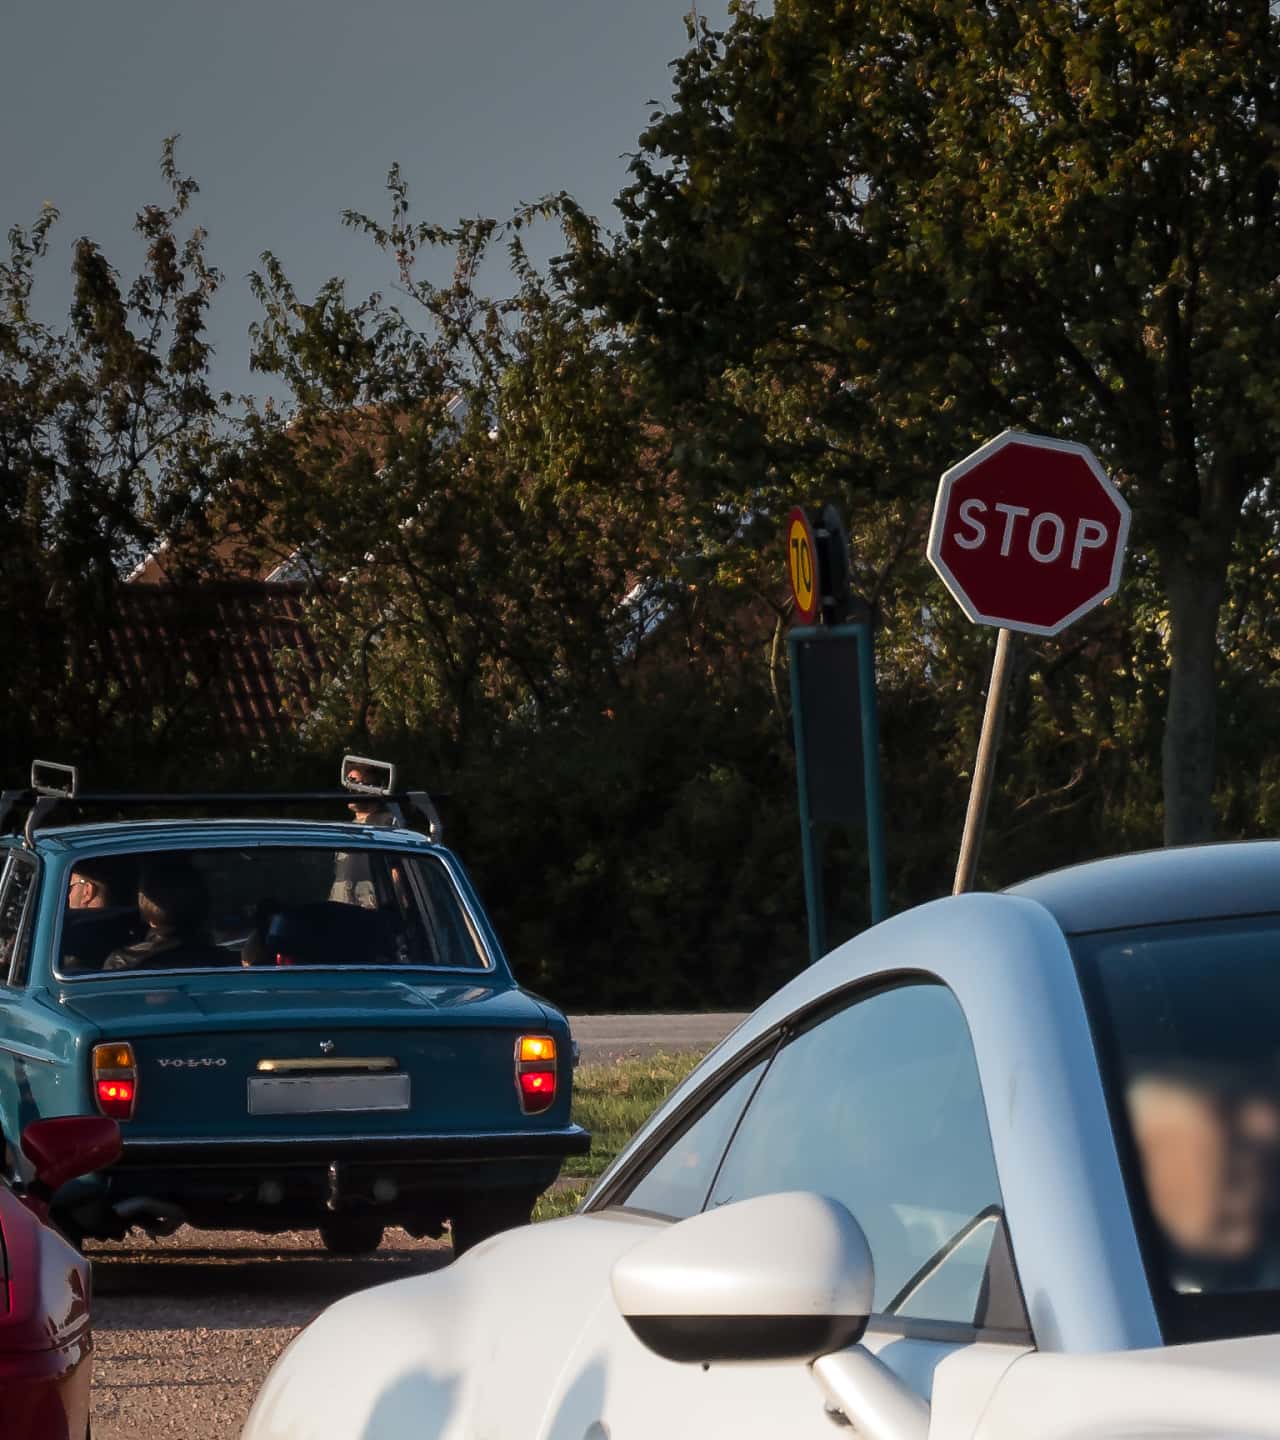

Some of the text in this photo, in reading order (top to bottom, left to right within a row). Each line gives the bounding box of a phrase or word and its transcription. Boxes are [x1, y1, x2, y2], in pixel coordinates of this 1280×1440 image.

[953, 499, 1108, 570] STOP
[792, 538, 811, 594] 70
[158, 1058, 227, 1067] VOLVO
